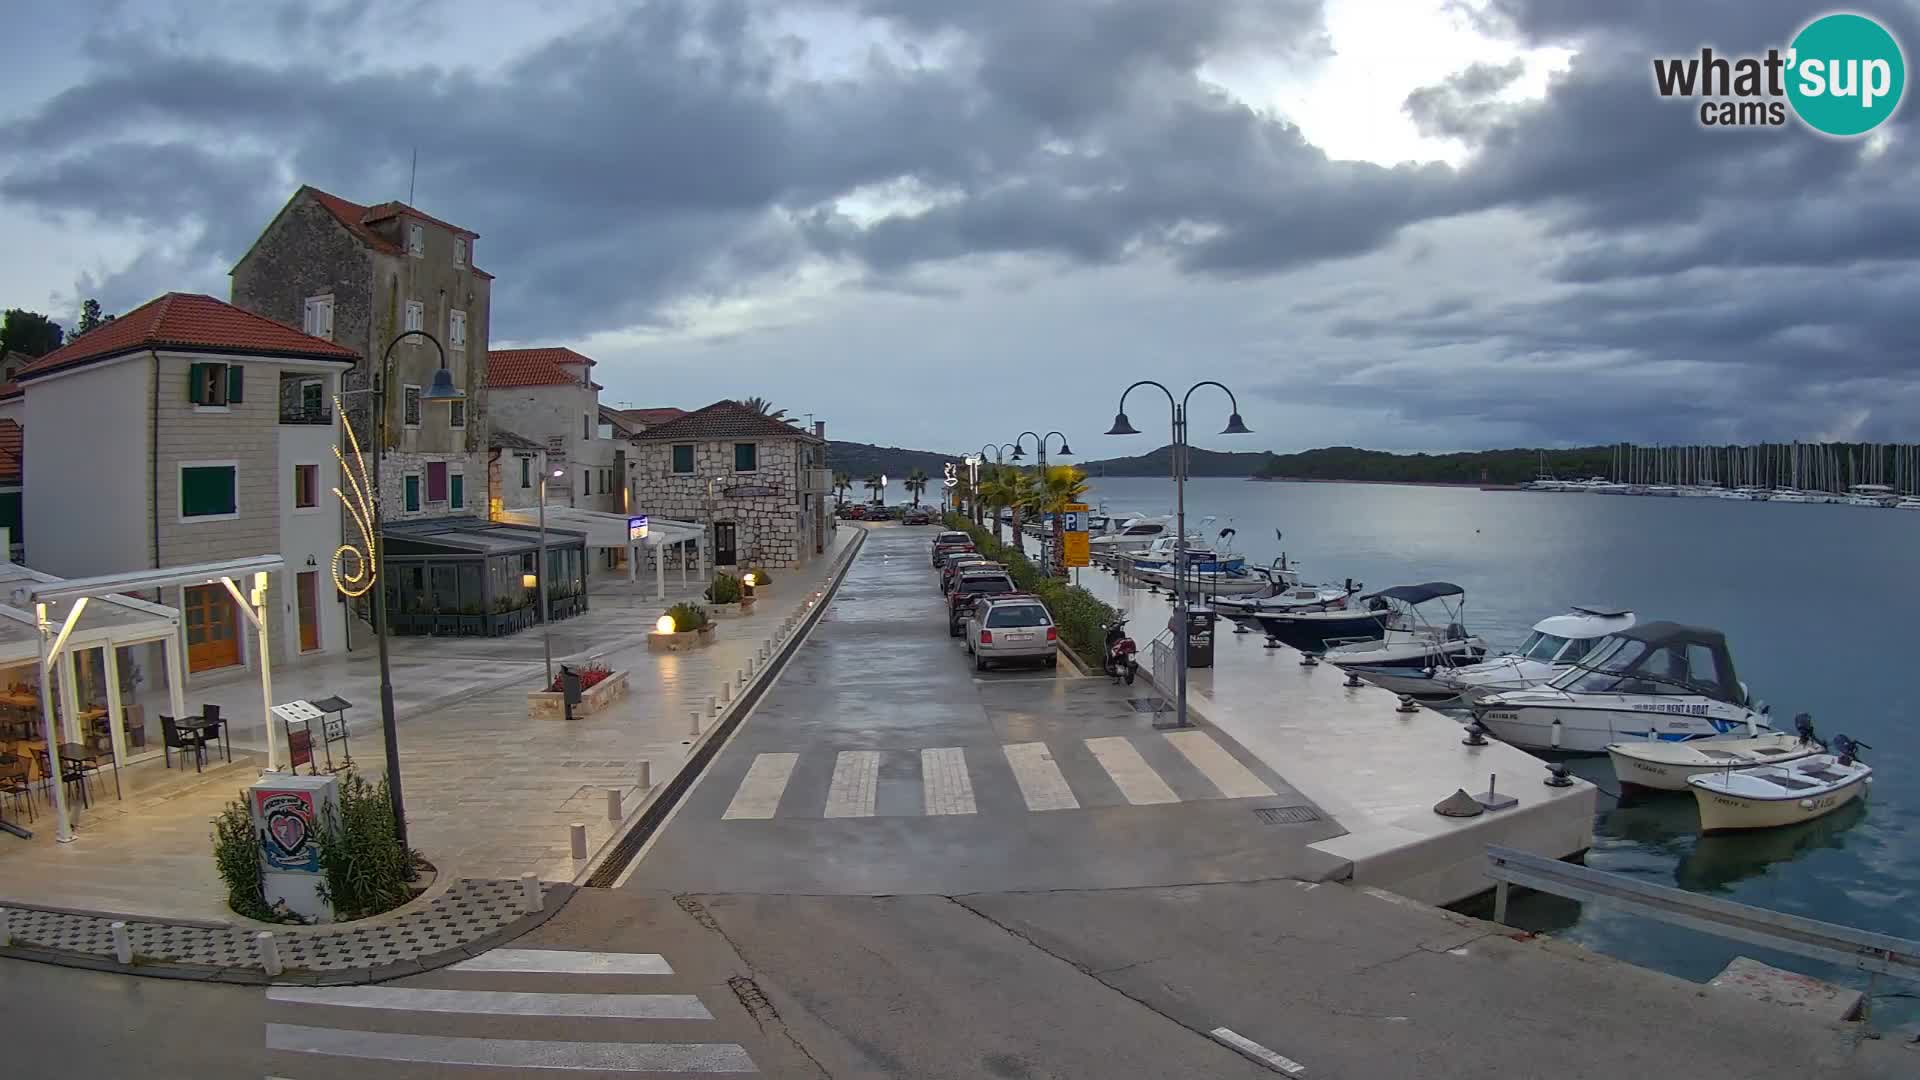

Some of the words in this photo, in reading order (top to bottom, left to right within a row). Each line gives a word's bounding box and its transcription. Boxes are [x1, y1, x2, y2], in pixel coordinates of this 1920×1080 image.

[1066, 514, 1076, 530] P
[1666, 704, 1685, 713] RENT
[1686, 704, 1691, 713] A
[1692, 704, 1710, 715] BOAT
